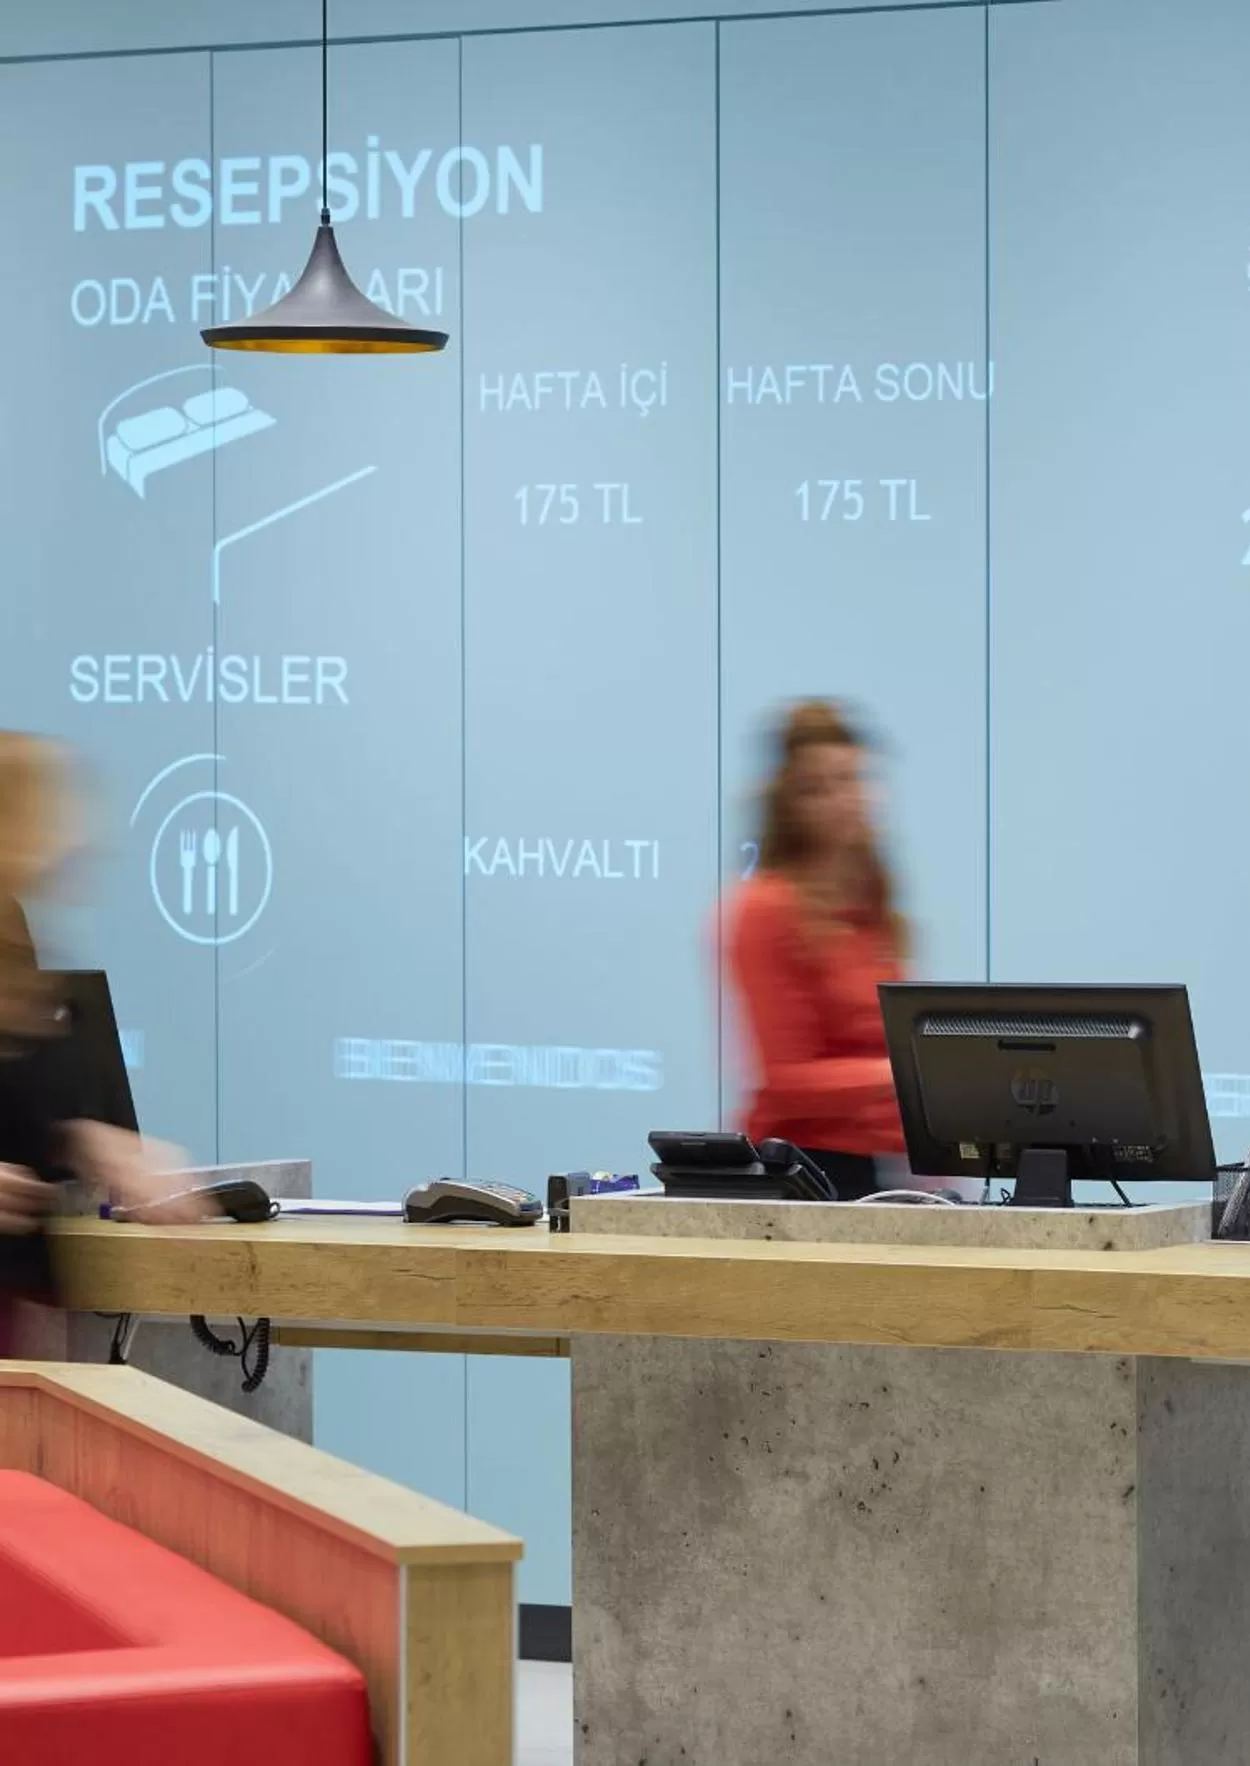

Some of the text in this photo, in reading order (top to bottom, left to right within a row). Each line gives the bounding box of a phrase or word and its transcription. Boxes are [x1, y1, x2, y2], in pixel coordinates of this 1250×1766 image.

[72, 135, 544, 232] RESEPSİYON
[70, 266, 444, 328] ODA FİYAARI
[479, 362, 668, 417] HAFTA İÇİ
[726, 360, 995, 405] HAFTA SONU
[514, 483, 643, 525] 175 TL
[794, 478, 932, 521] 175 TL
[69, 645, 350, 704] SERVİSLER
[463, 836, 660, 881] KAHVALTI
